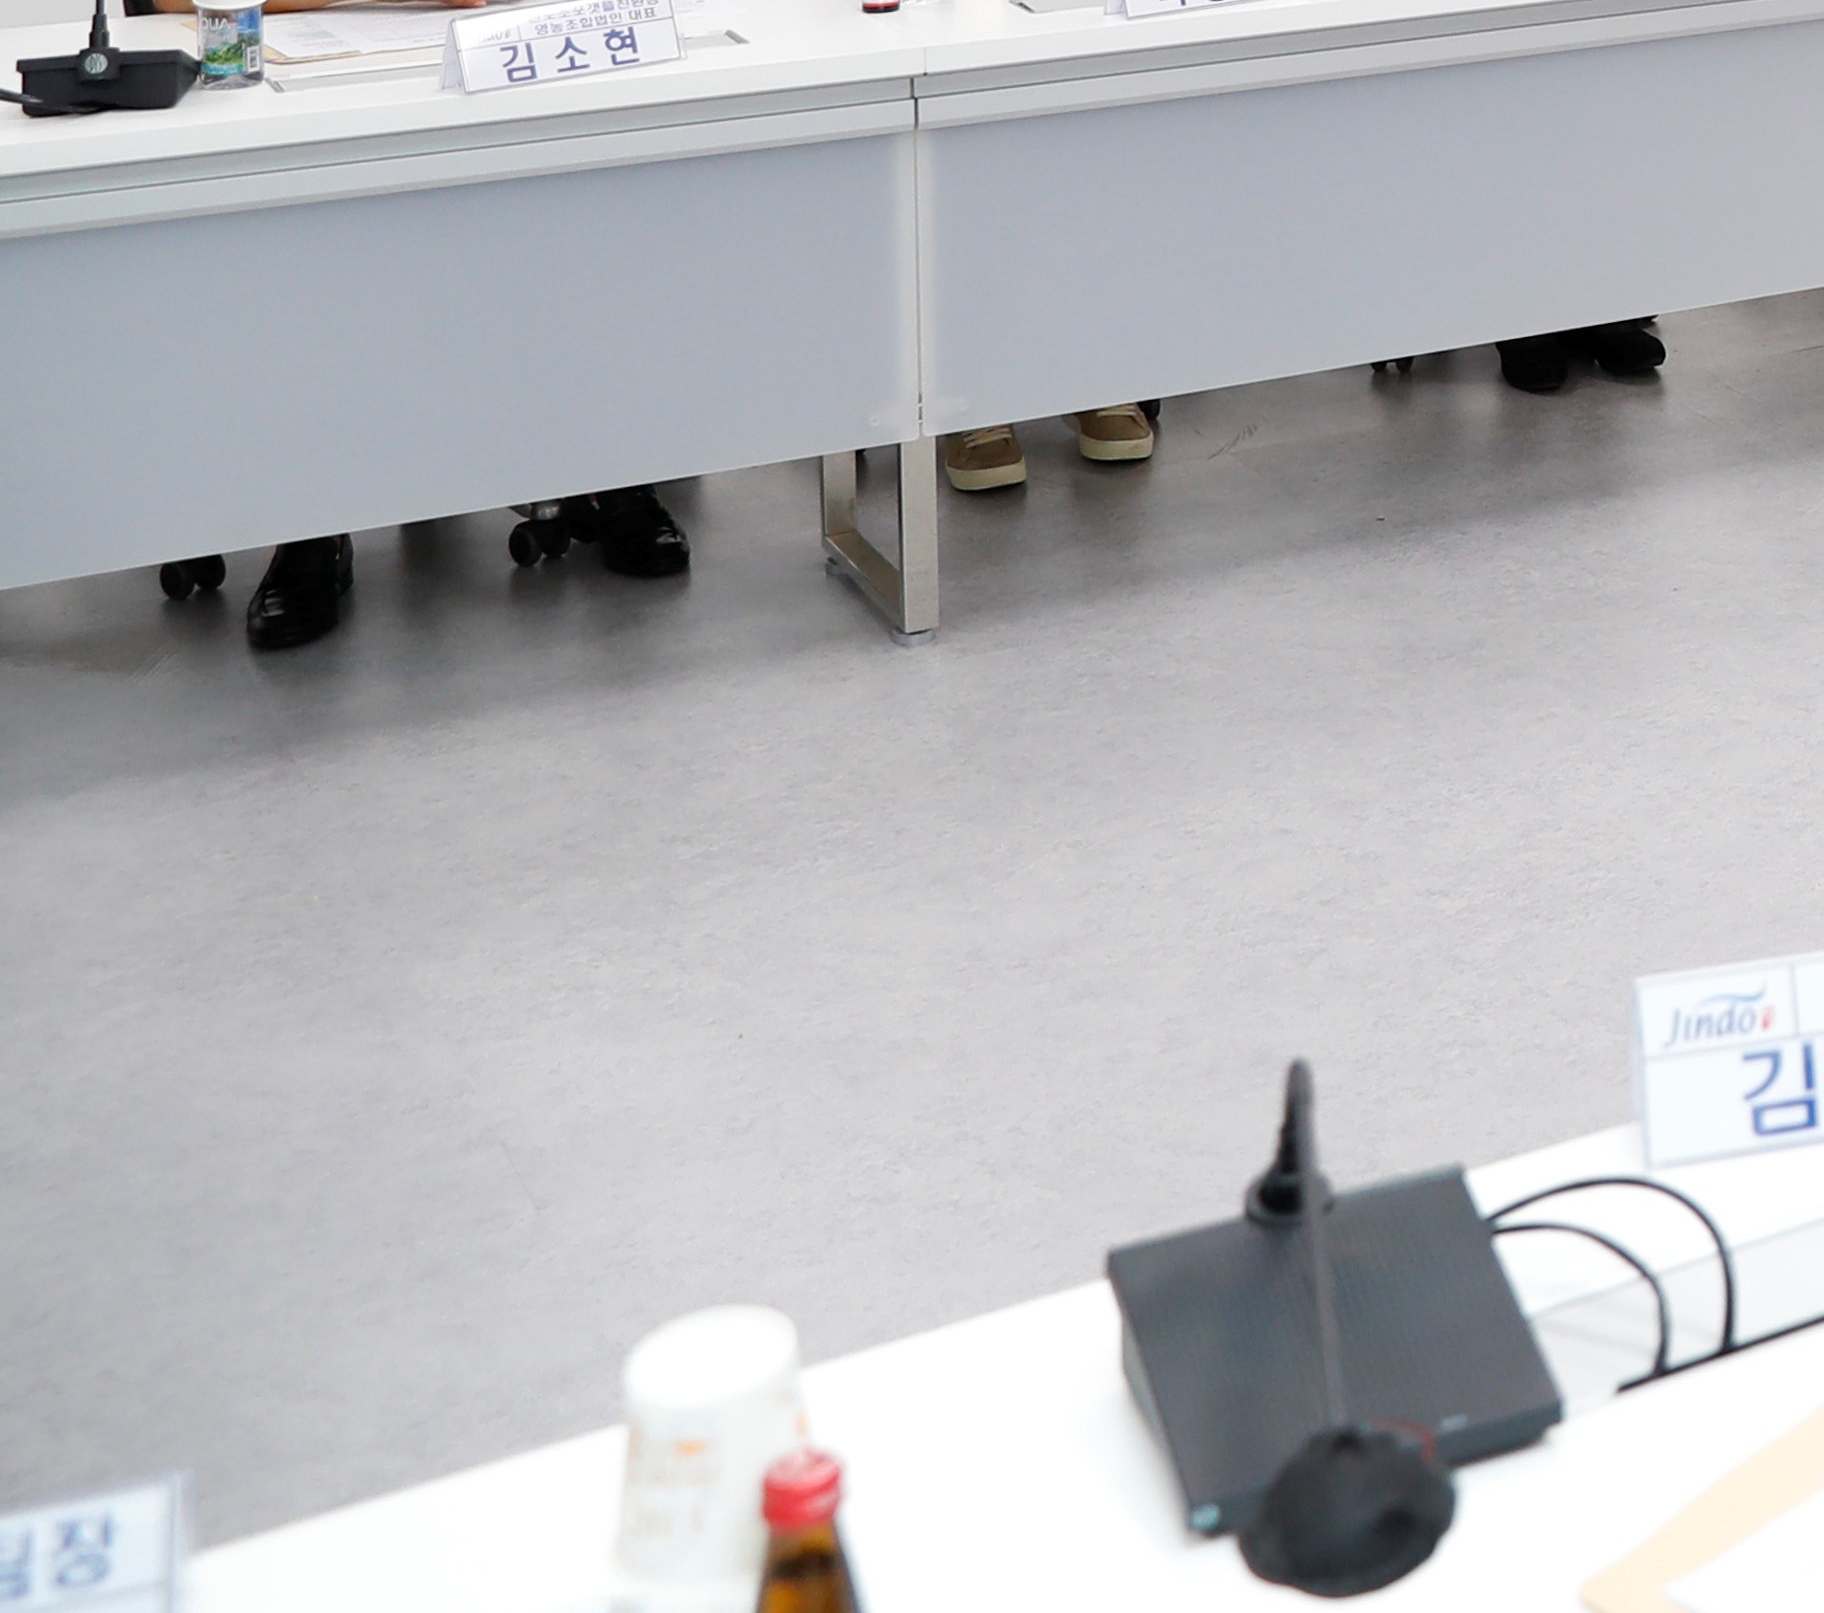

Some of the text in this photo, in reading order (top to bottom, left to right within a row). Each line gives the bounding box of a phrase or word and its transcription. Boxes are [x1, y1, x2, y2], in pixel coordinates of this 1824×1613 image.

[535, 12, 624, 36] 영농조합법인
[628, 6, 657, 21] 대표
[500, 26, 641, 83] 김소현
[1663, 998, 1757, 1049] Jindo
